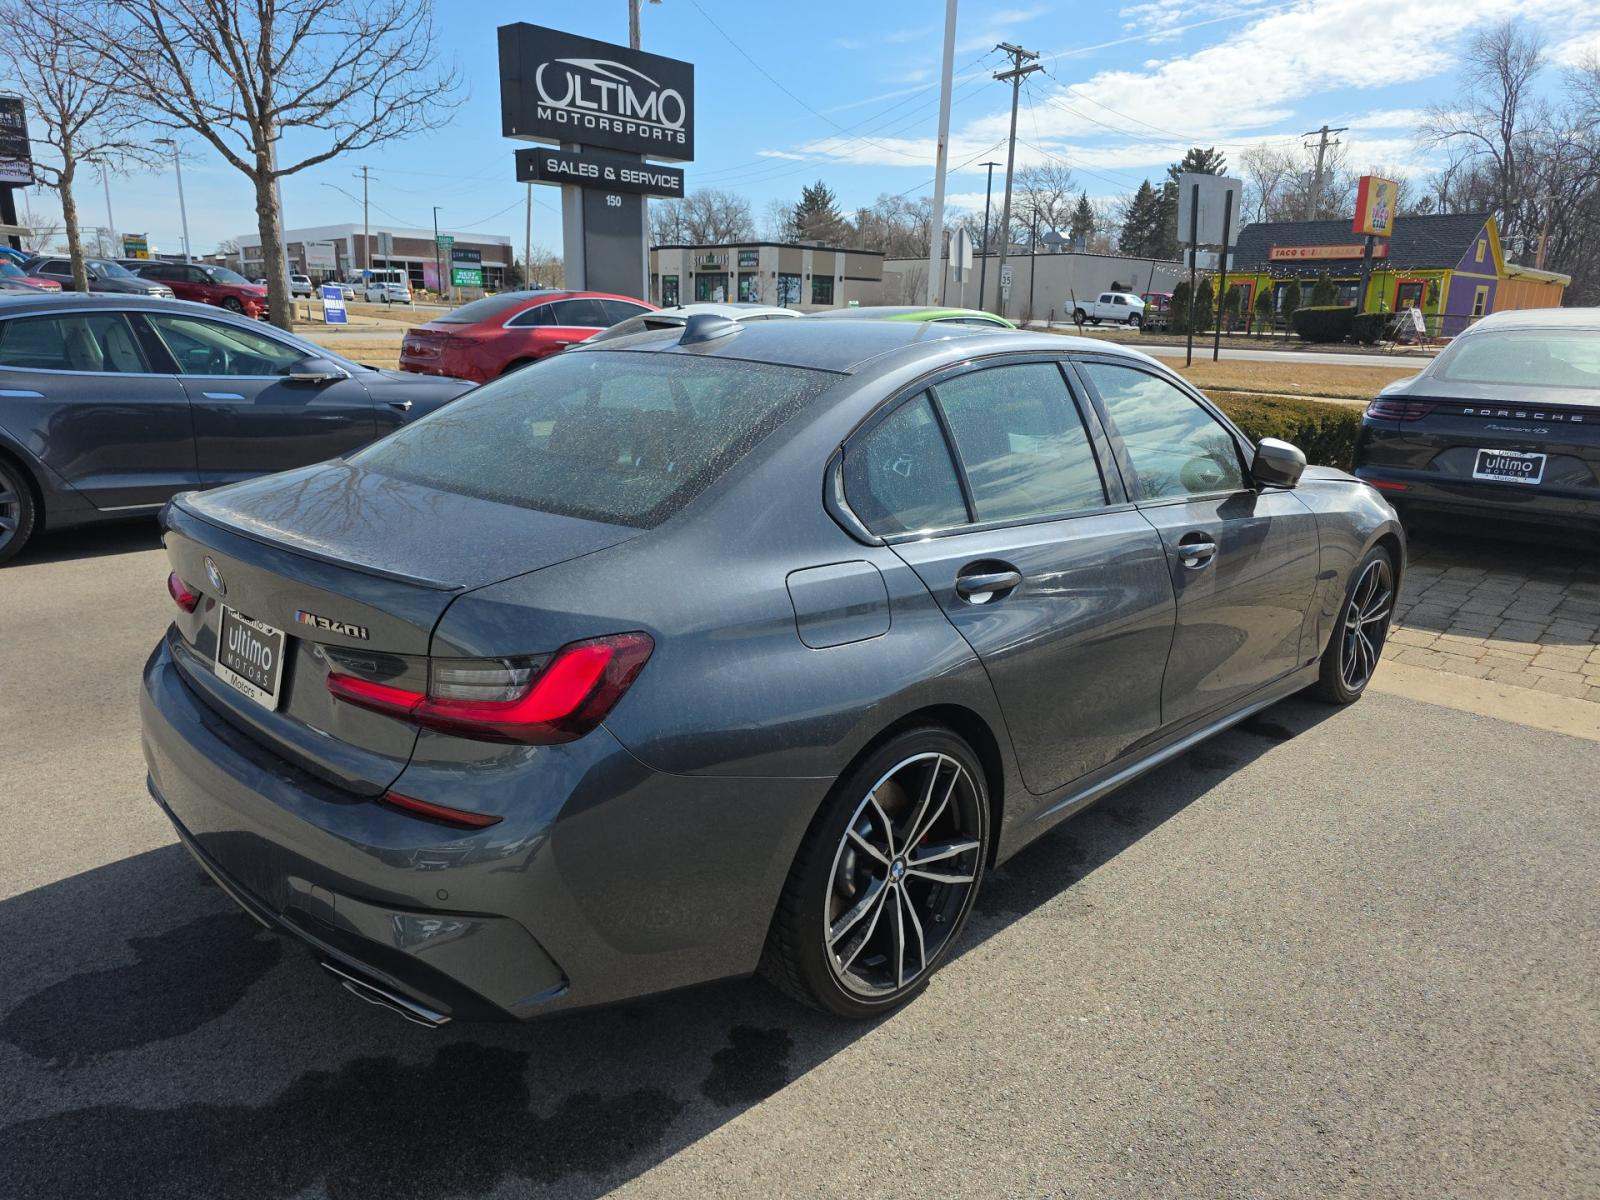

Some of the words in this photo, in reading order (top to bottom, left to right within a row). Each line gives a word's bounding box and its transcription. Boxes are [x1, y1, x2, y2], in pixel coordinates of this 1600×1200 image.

[535, 62, 686, 129] ULTIMO
[537, 106, 687, 144] MOTORSPORTS
[546, 158, 599, 178] SALES
[604, 167, 616, 180] &
[620, 169, 680, 189] SERVICE
[606, 194, 622, 207] 150
[1275, 249, 1297, 257] TACO
[1002, 276, 1011, 285] 35
[1463, 408, 1584, 422] PORSCHE
[1485, 468, 1529, 477] MOTORS
[1486, 456, 1533, 471] ultimo
[302, 610, 369, 640] M340i
[228, 624, 272, 671] ultimo
[227, 653, 268, 687] MOTORS
[230, 673, 255, 698] Motors
